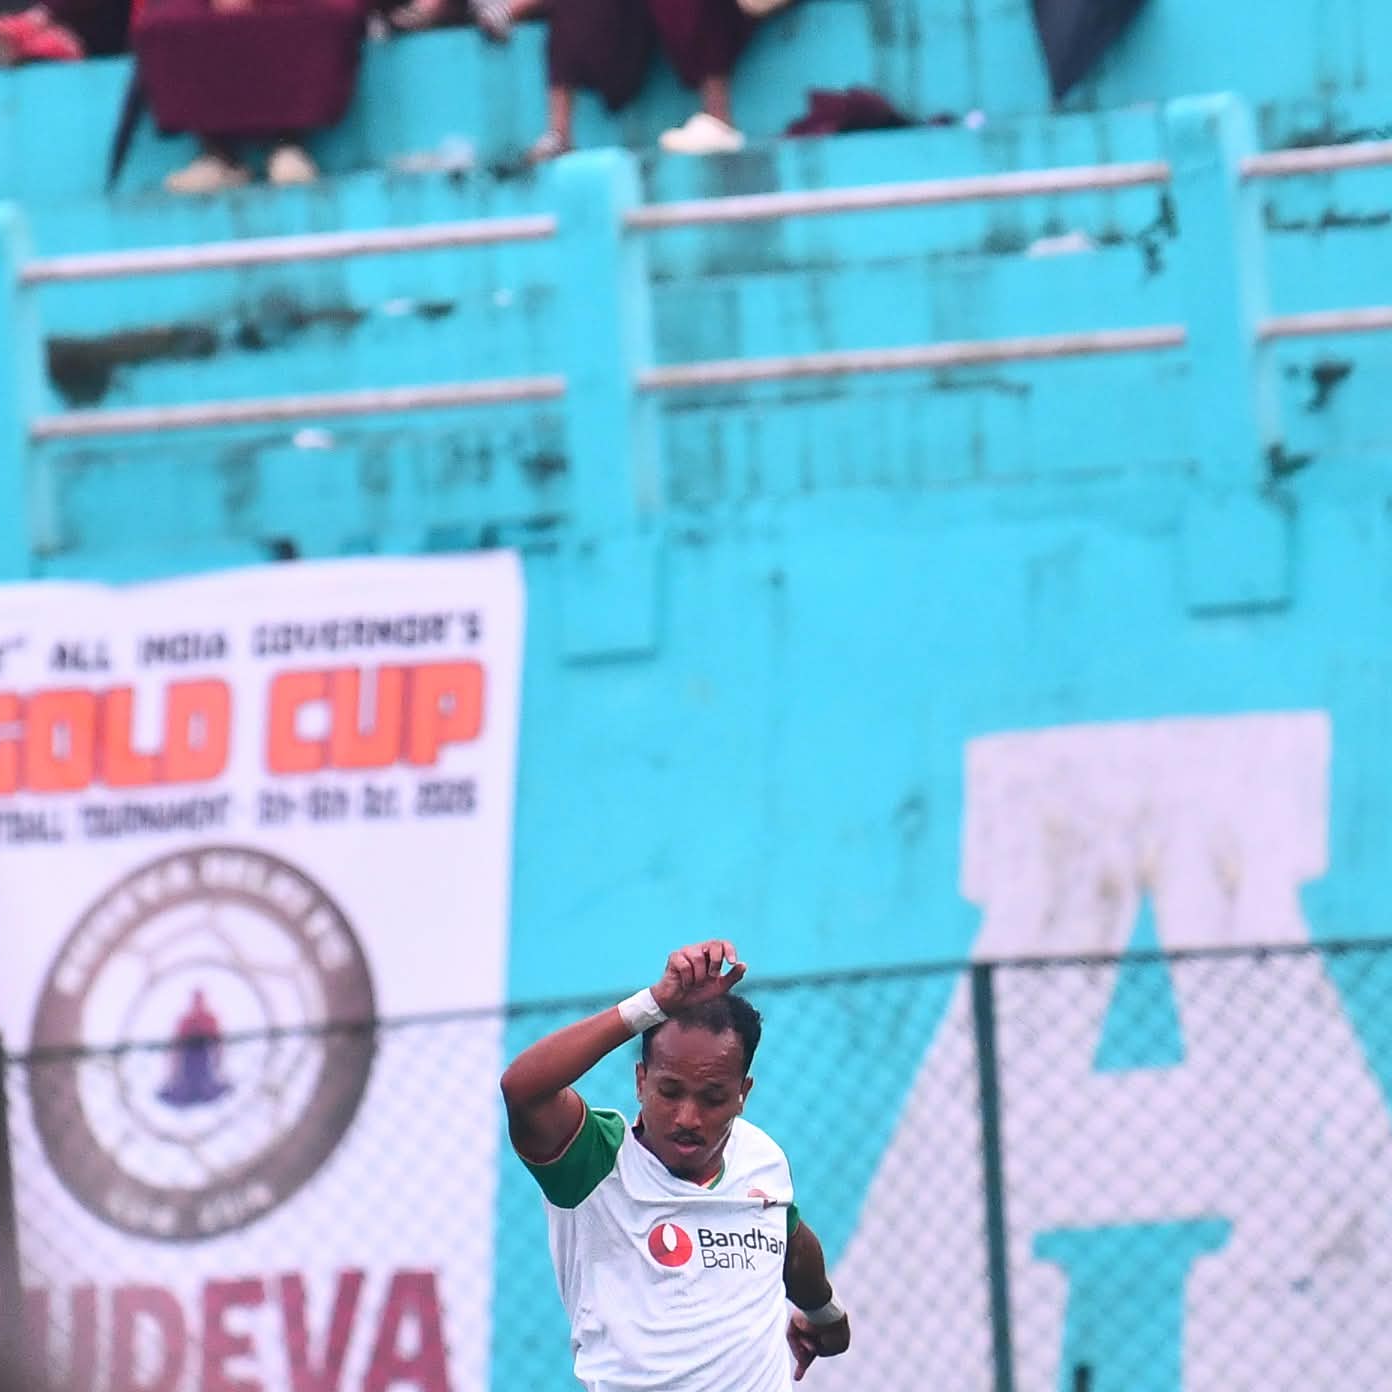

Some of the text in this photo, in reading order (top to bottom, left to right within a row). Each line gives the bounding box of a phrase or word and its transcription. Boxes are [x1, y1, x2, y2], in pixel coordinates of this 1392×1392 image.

[50, 638, 112, 672] ALL
[138, 630, 229, 668] INDIA
[265, 660, 484, 775] CUP
[701, 1247, 756, 1271] Bank
